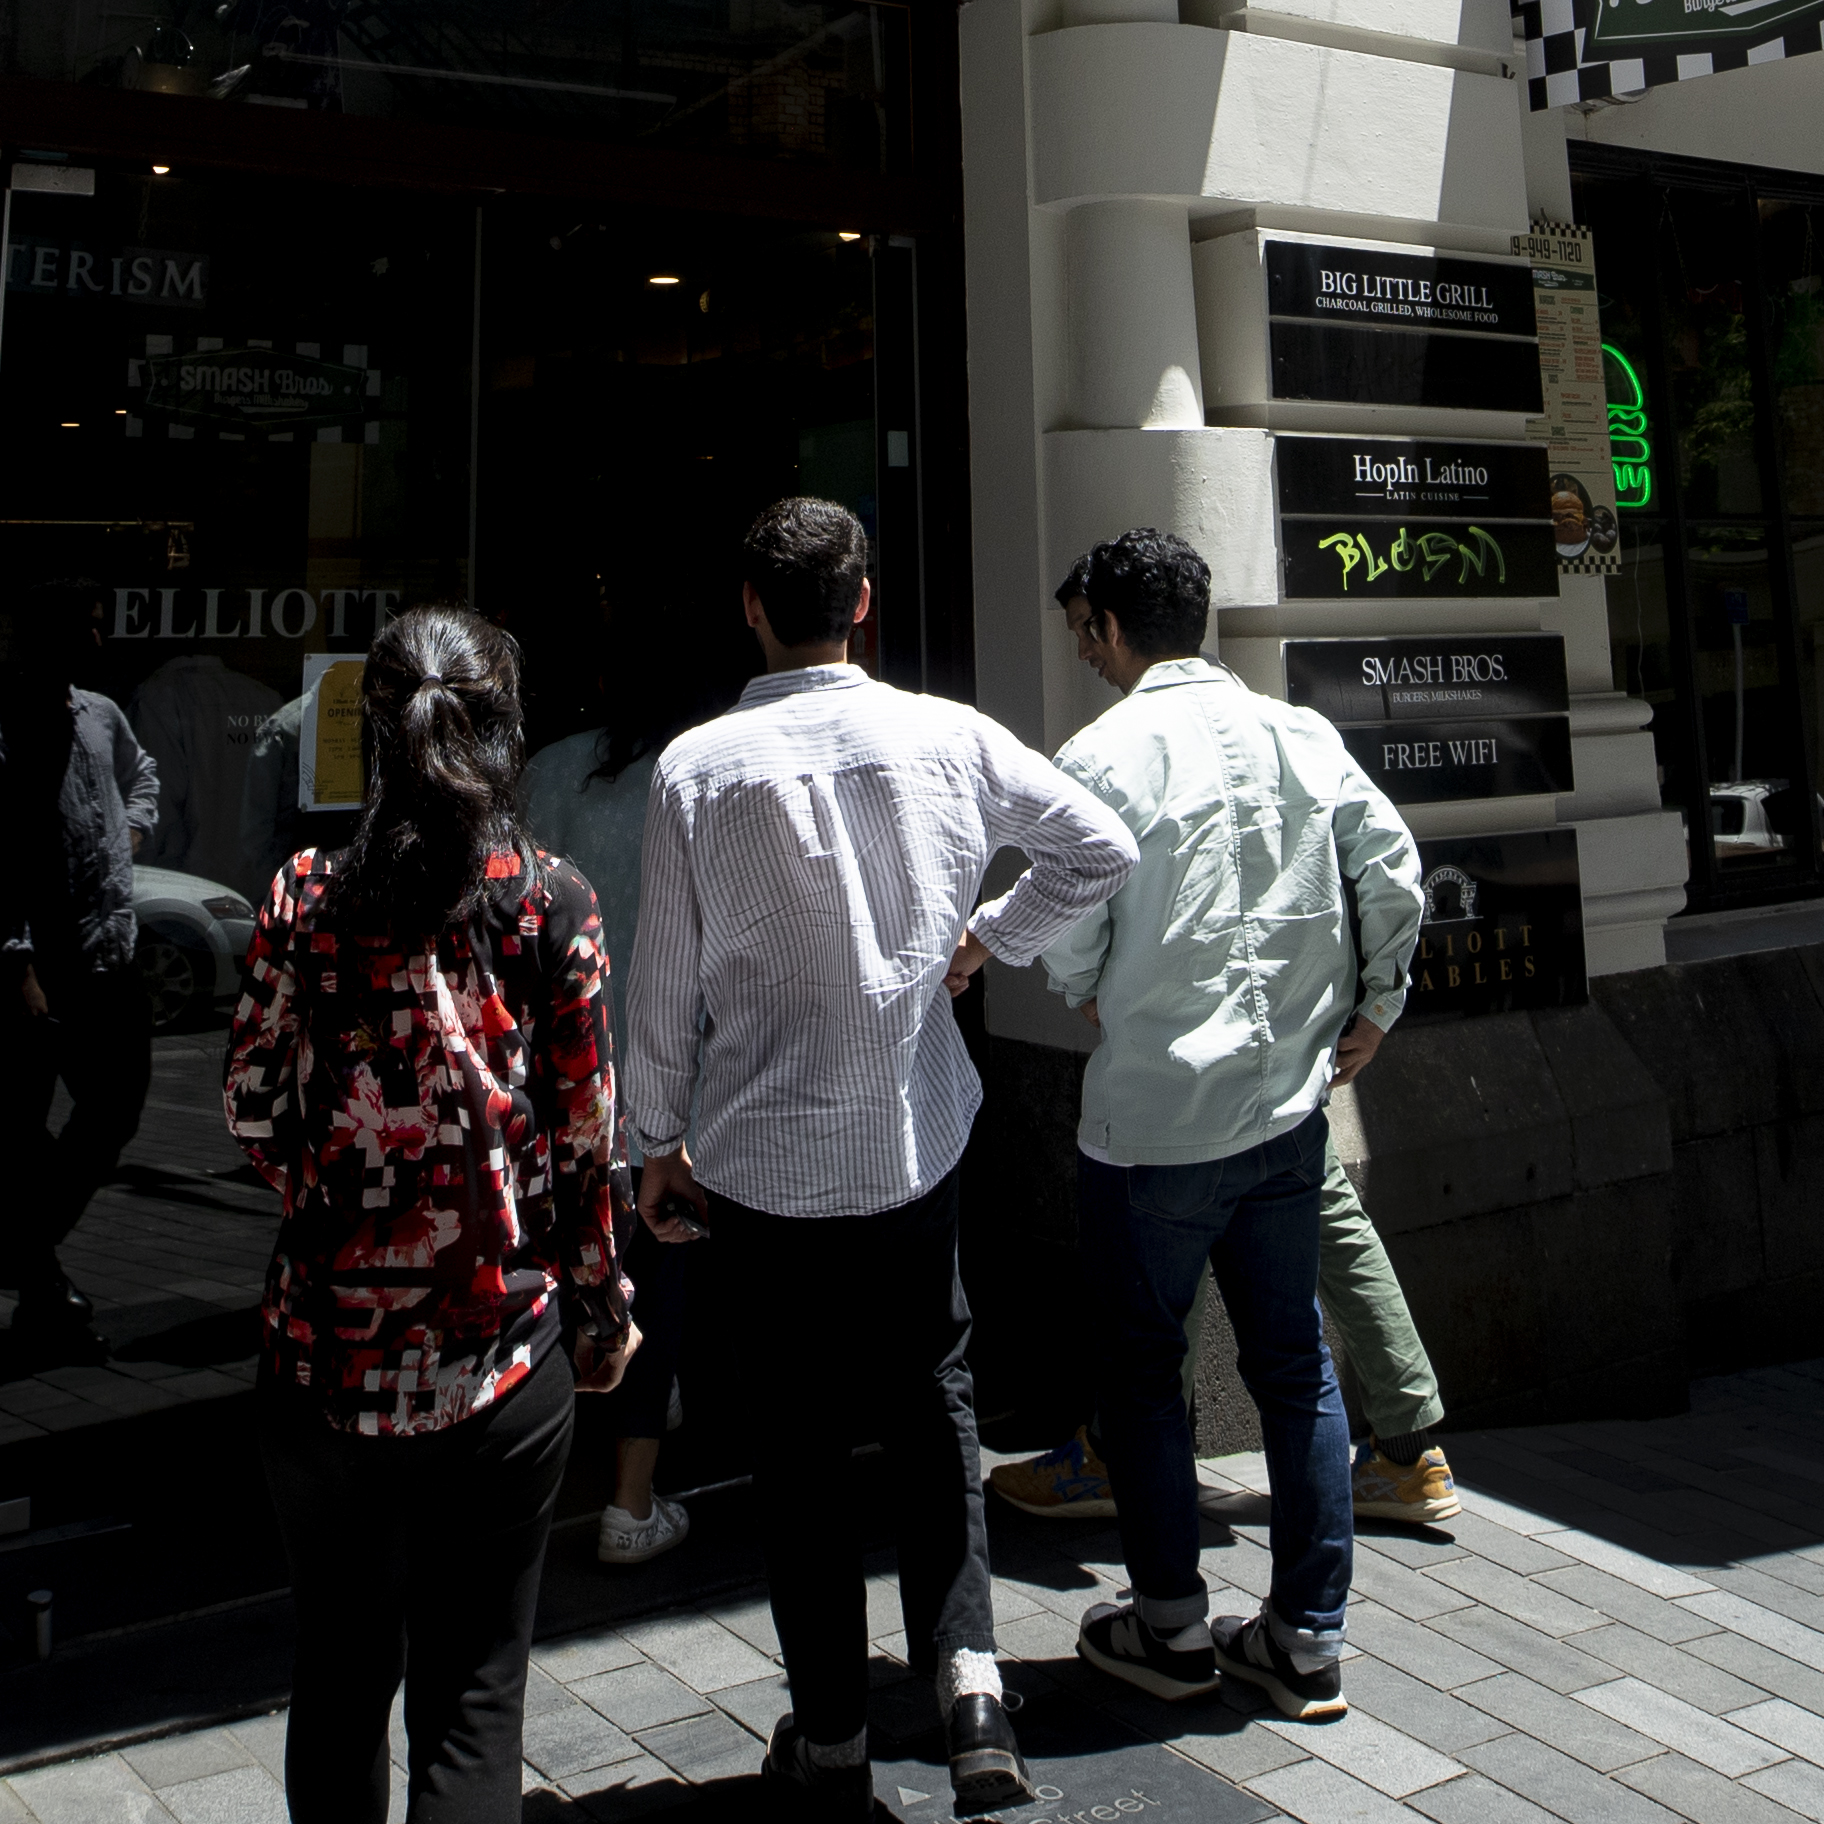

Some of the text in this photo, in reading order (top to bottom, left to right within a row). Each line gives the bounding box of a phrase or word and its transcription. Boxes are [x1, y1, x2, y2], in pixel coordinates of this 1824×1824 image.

[1510, 236, 1582, 262] 9-949-1120
[1320, 269, 1494, 309] BIG LITTLE GRILL
[1315, 296, 1499, 325] CHARCOAL GRILLED, WHOLESOME FOOD
[179, 365, 334, 395] SMASH Bros
[1353, 455, 1488, 489] HopIn Latino
[1386, 491, 1460, 501] LATIN CUISINE
[108, 588, 402, 639] ELLIOTT
[1362, 654, 1508, 686] SMASH BROS.
[1432, 689, 1482, 702] MILKSHAKES
[227, 715, 249, 727] NO
[1383, 738, 1498, 770] FREE WIFI
[1420, 925, 1533, 960] LIOTT
[1420, 956, 1535, 992] ABLES
[1028, 1788, 1163, 1824] treet
